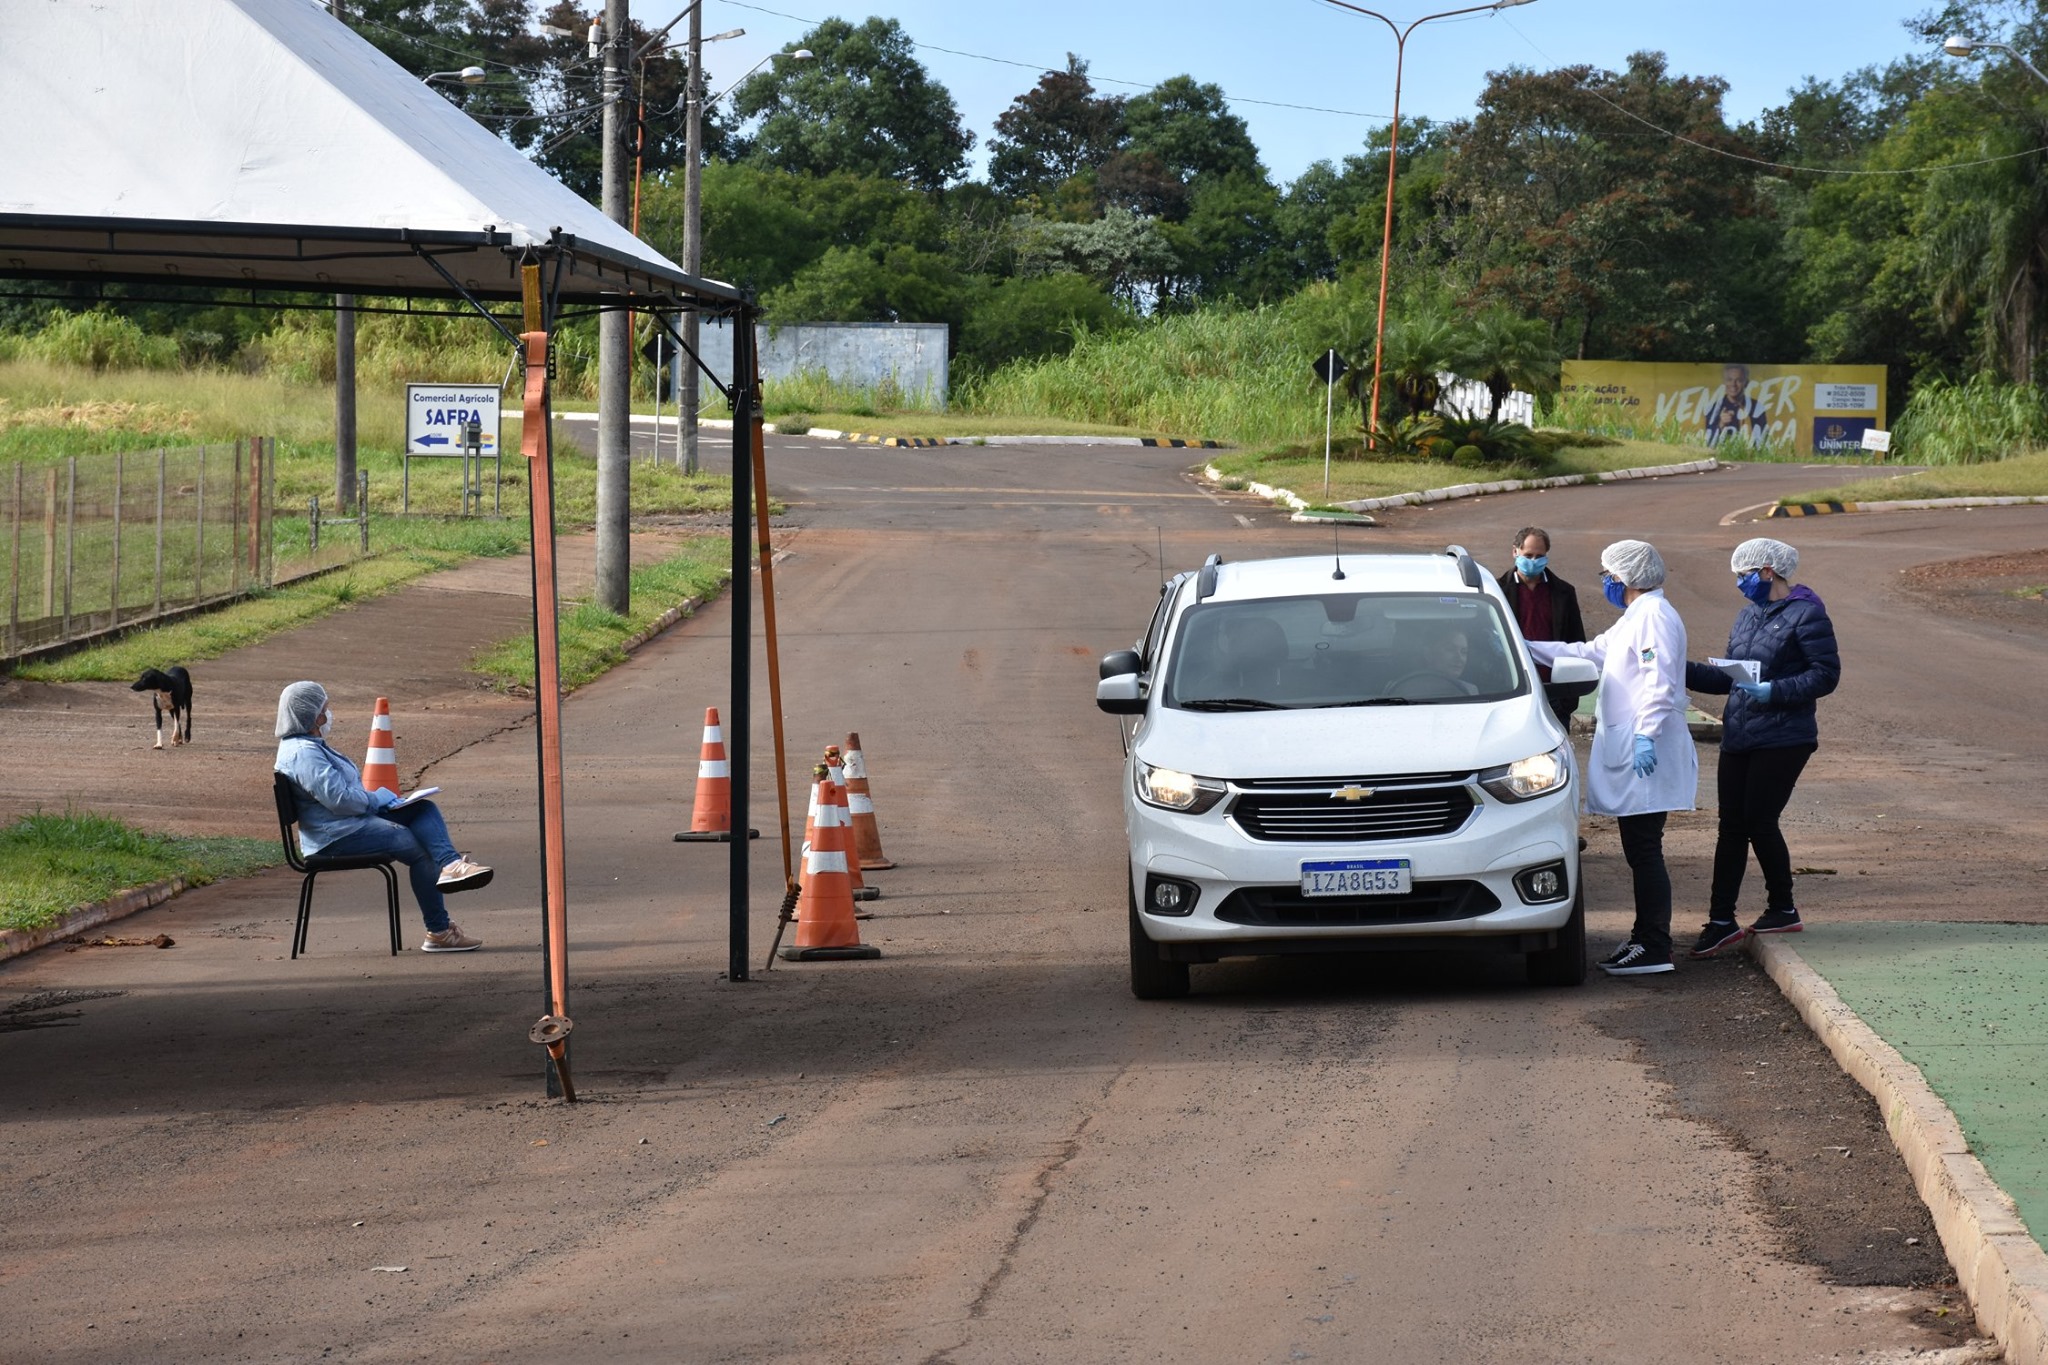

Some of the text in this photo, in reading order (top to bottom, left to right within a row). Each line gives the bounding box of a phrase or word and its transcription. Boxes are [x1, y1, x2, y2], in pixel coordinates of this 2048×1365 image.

[413, 393, 494, 404] Comercial Agrícola
[1655, 375, 1801, 429] VEM SER
[426, 409, 481, 425] SAFRA
[1820, 440, 1861, 449] UNINTER
[1312, 871, 1399, 892] IZA8G53
